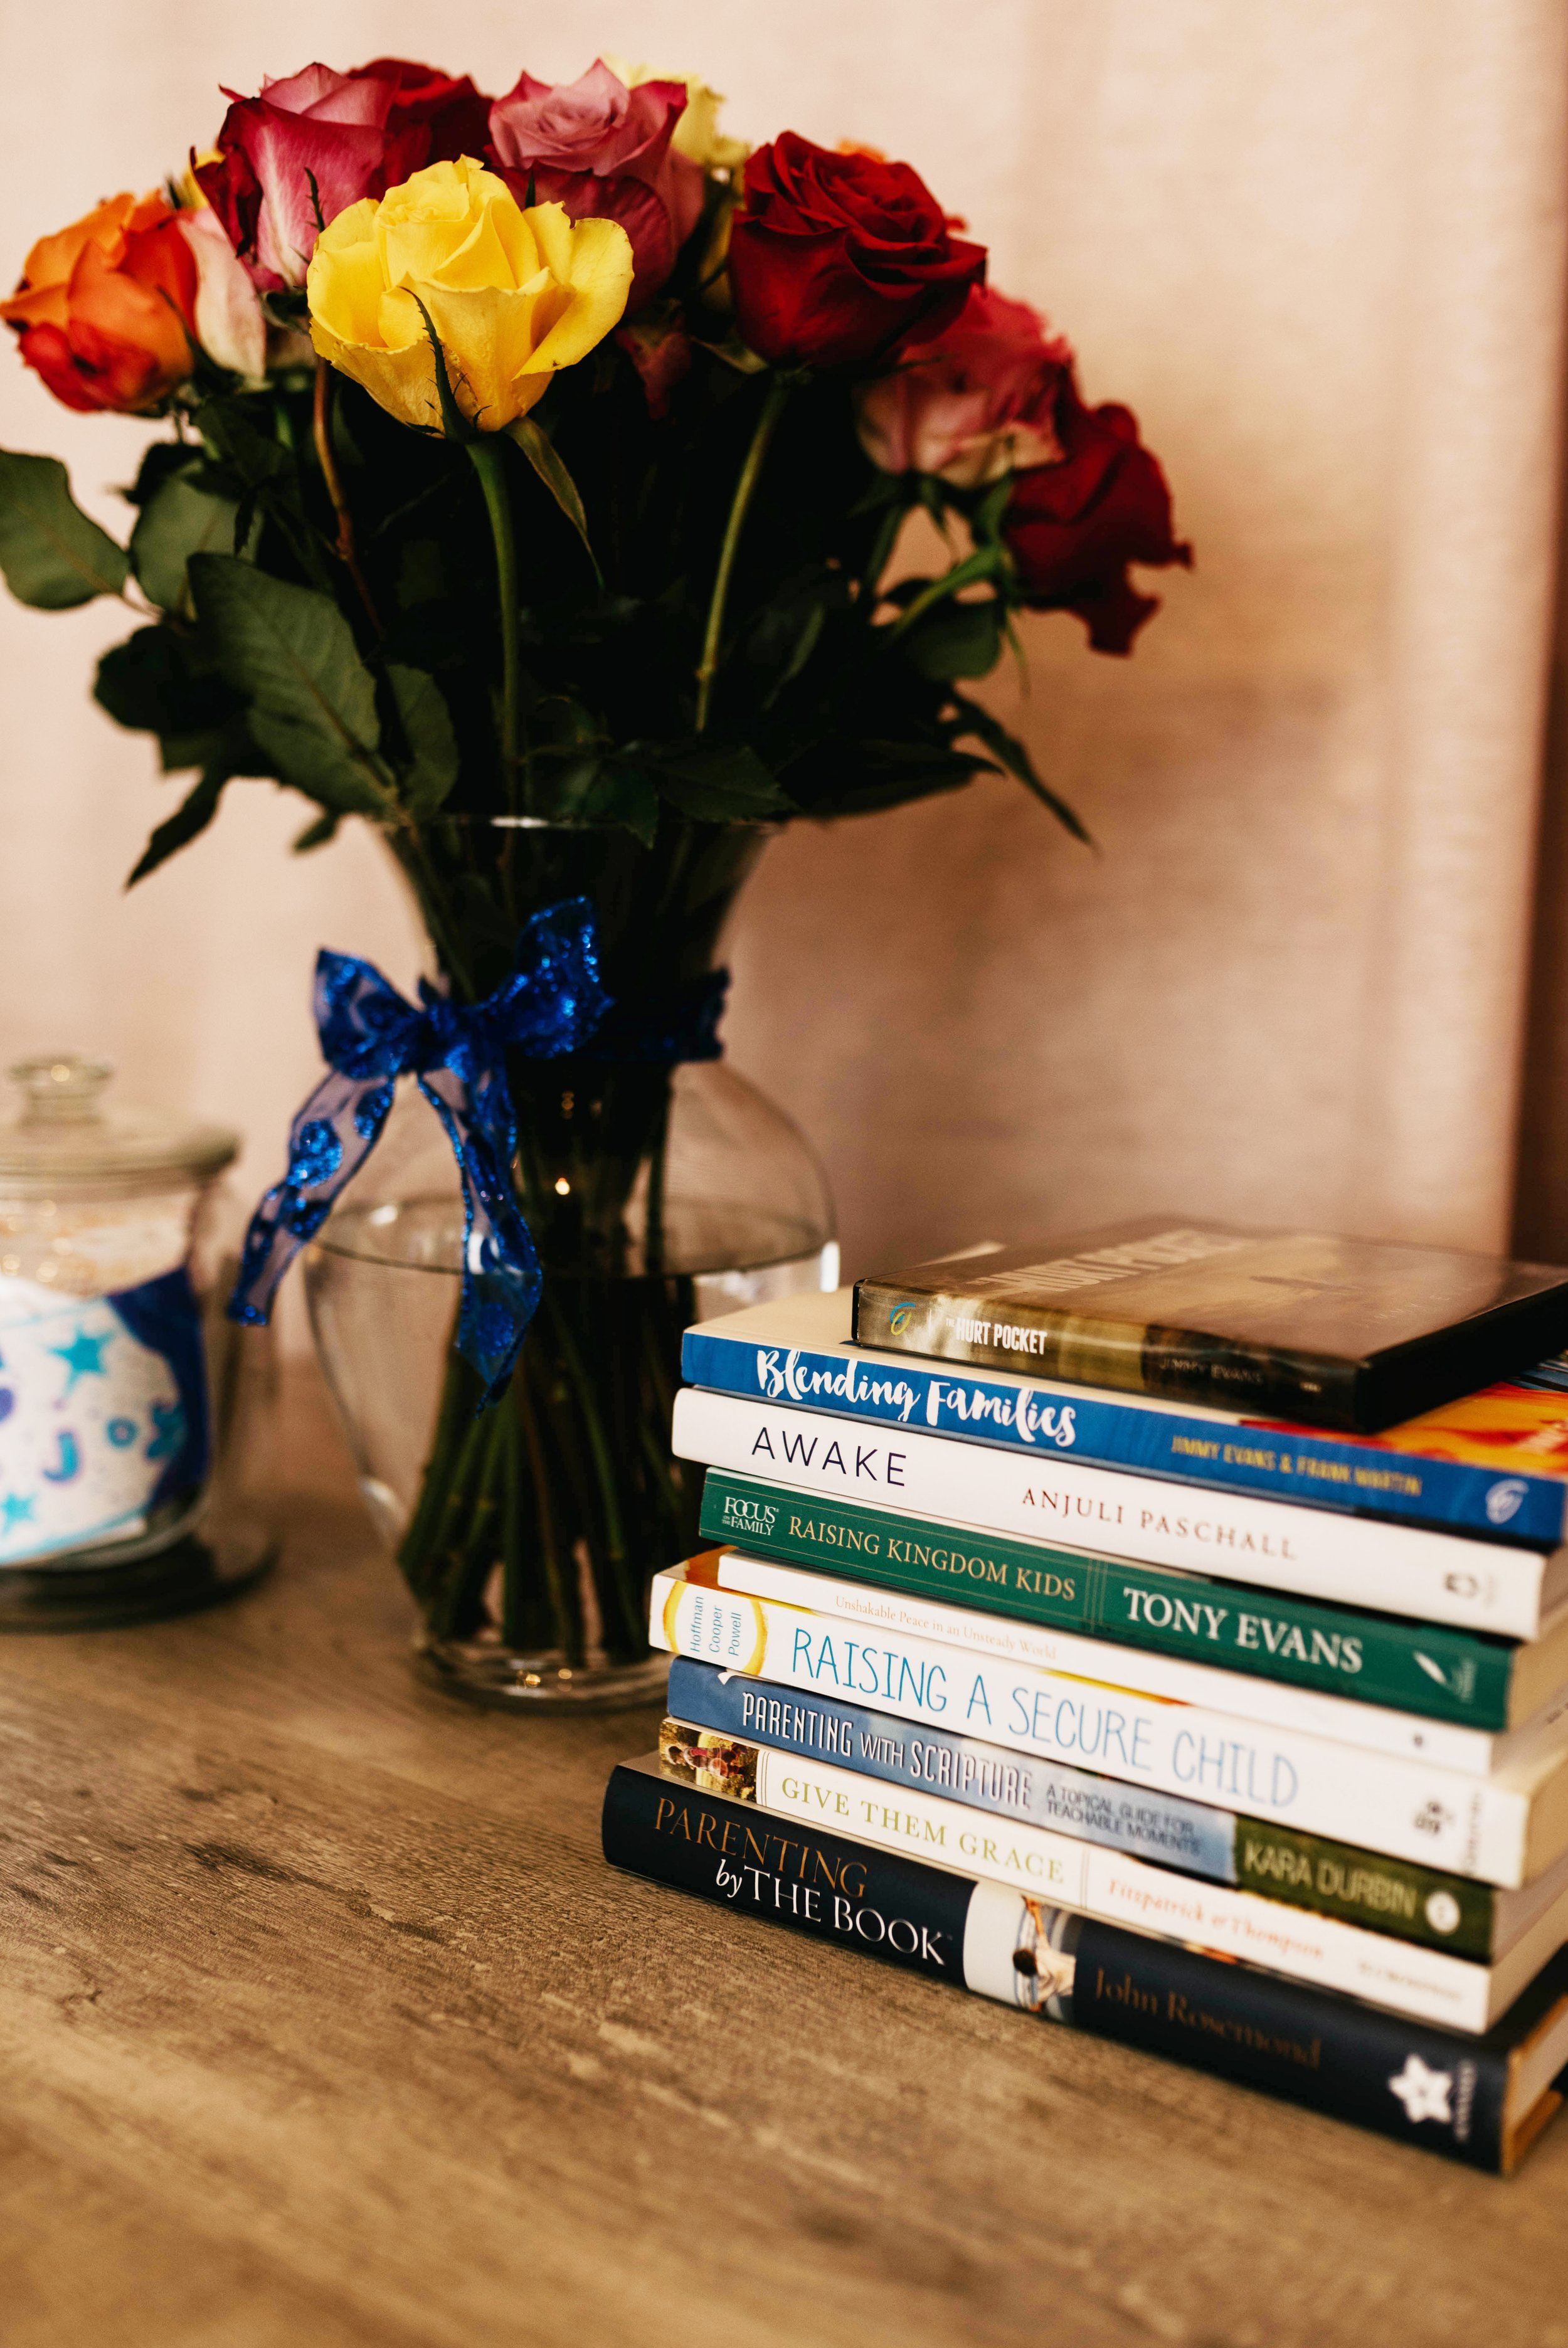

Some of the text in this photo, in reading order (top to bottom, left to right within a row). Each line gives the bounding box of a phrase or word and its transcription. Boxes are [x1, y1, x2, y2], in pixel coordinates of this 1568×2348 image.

[956, 1318, 991, 1345] HURT
[994, 1325, 1047, 1355] POCKET
[757, 1349, 1076, 1446] Blending Families
[752, 1427, 906, 1486] AWAKE
[1172, 1436, 1422, 1496] JIMMY EVANS & FRANK MARTIN
[731, 1516, 774, 1535] FAMILY
[789, 1516, 1076, 1601] RAISING KINGDOM KIDS
[1023, 1488, 1296, 1560] ANJULI PASCHALL
[689, 1596, 704, 1652] Hoffman
[709, 1605, 723, 1653] Cooper
[728, 1612, 742, 1656] Powell
[835, 1595, 1057, 1660] Unshakable Peace in an Unsteady World
[1124, 1587, 1363, 1673] TONY EVANS
[742, 1692, 1032, 1811] PARENTING WITH SCRIPTURE
[793, 1627, 1298, 1808] RAISING A SECURE CHILD
[781, 1777, 1064, 1884] GIVE THEM GRACE
[1046, 1783, 1194, 1835] A TOPICAL GUIDE FOR
[1047, 1801, 1200, 1855] TEACHABLE MOMENTS
[654, 1797, 868, 1898] PARENTING
[1244, 1840, 1417, 1920] KARA DURBIN
[715, 1859, 946, 1967] by THE BOOK
[1109, 1879, 1204, 1923] Fitzpatrick
[1231, 1916, 1324, 1960] Thompson
[1095, 1967, 1322, 2068] John Rosemond
